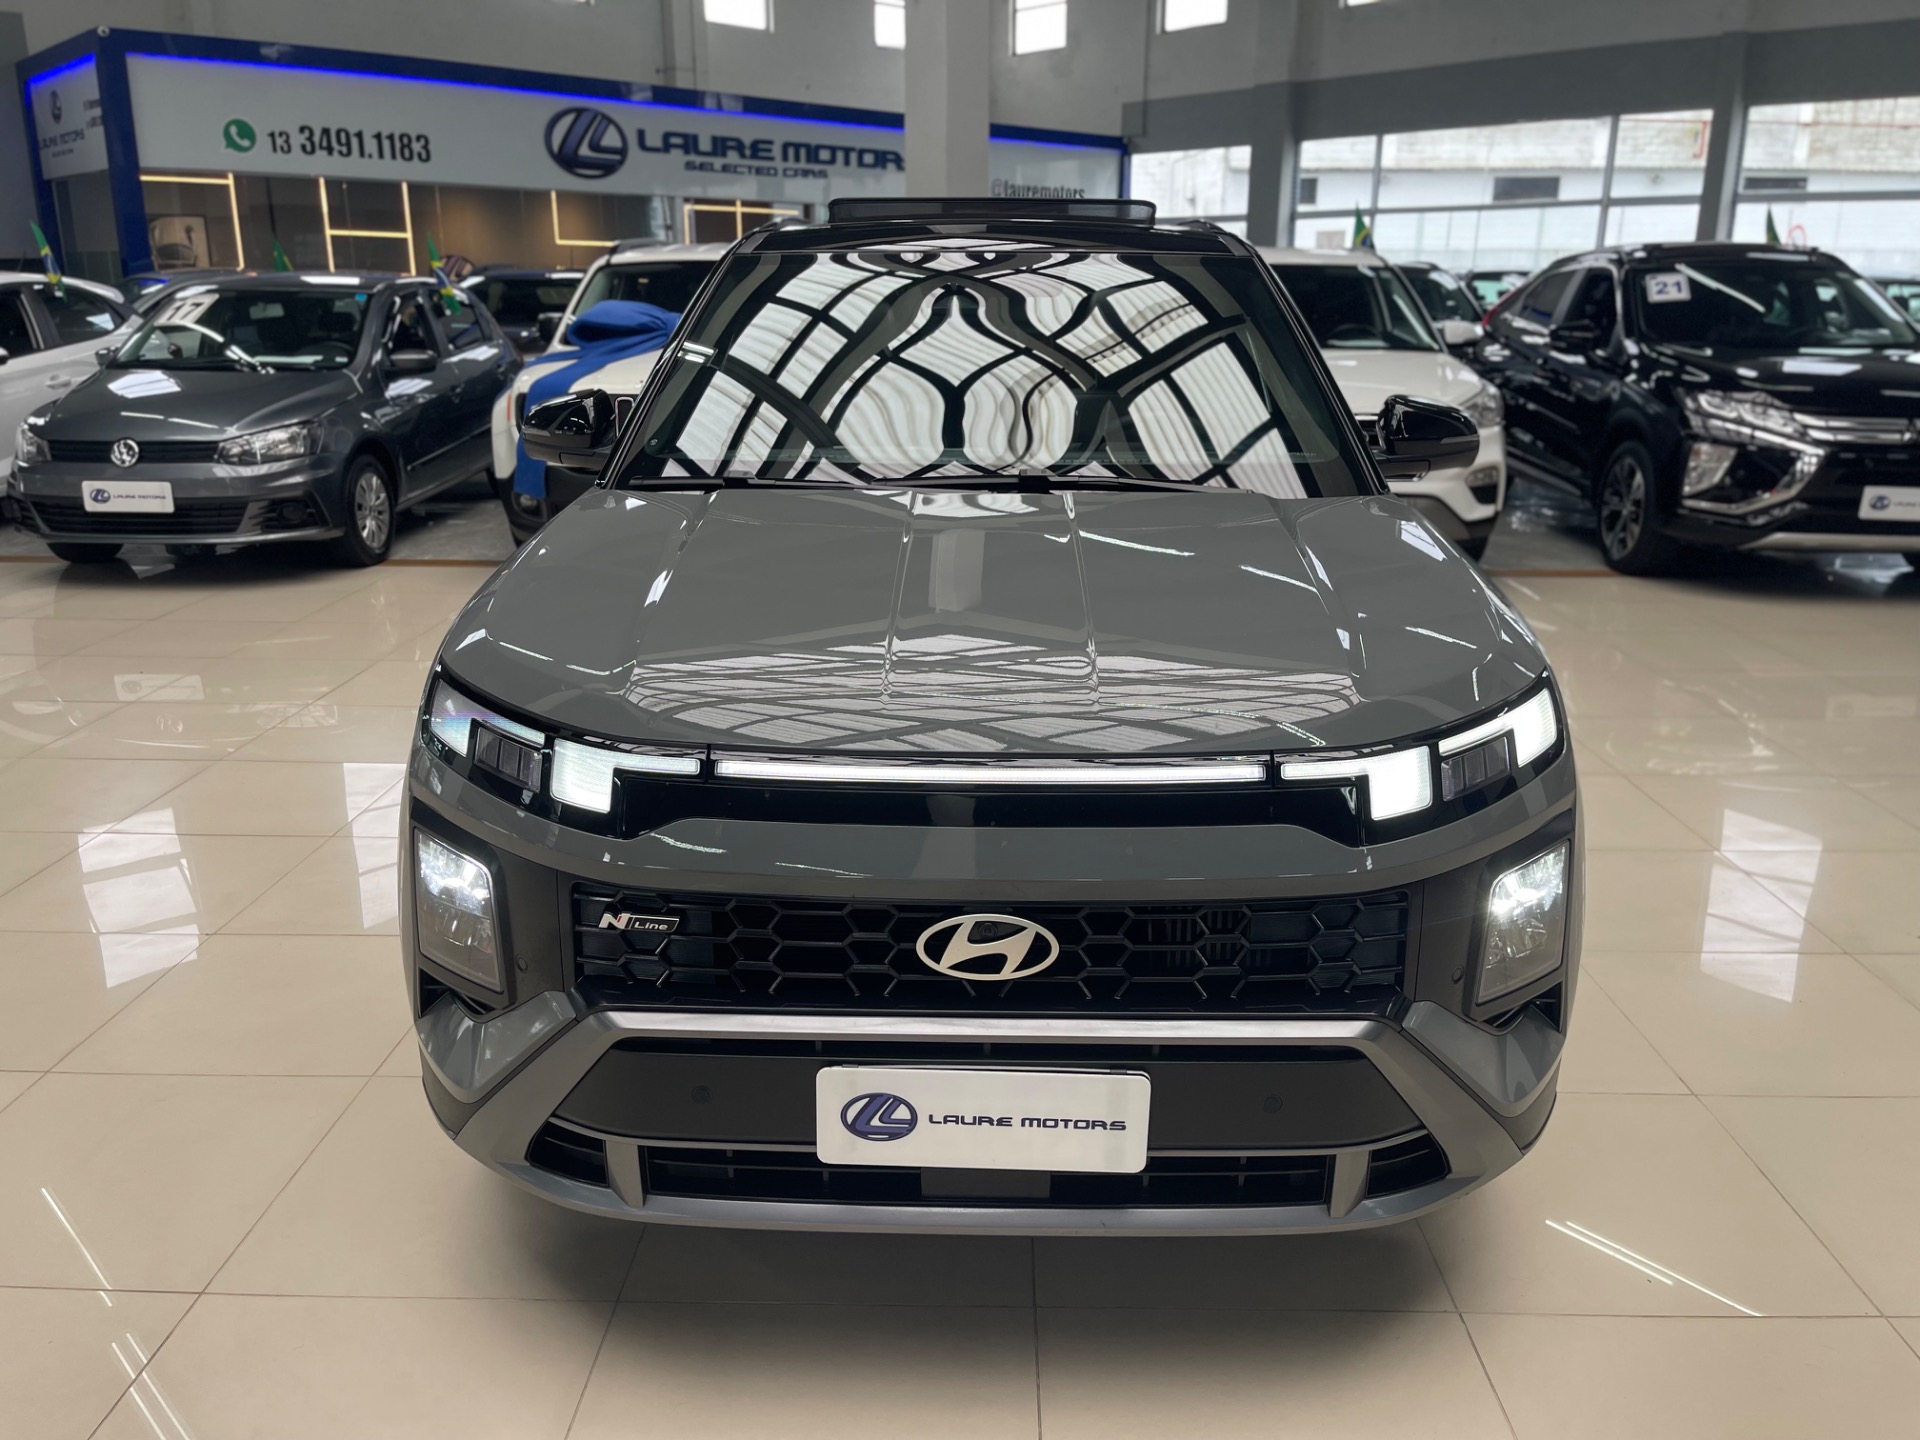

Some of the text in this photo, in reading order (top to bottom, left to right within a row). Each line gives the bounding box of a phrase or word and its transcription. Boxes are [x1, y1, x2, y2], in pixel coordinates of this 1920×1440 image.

[267, 125, 432, 163] 13 3491.1183
[637, 128, 906, 172] LAURE MOTOR
[684, 160, 829, 179] SELECTED CARS
[1655, 280, 1683, 295] 21
[166, 302, 206, 322] 17
[599, 913, 668, 931] N Line
[928, 1113, 1127, 1131] LAURE MOTORS
